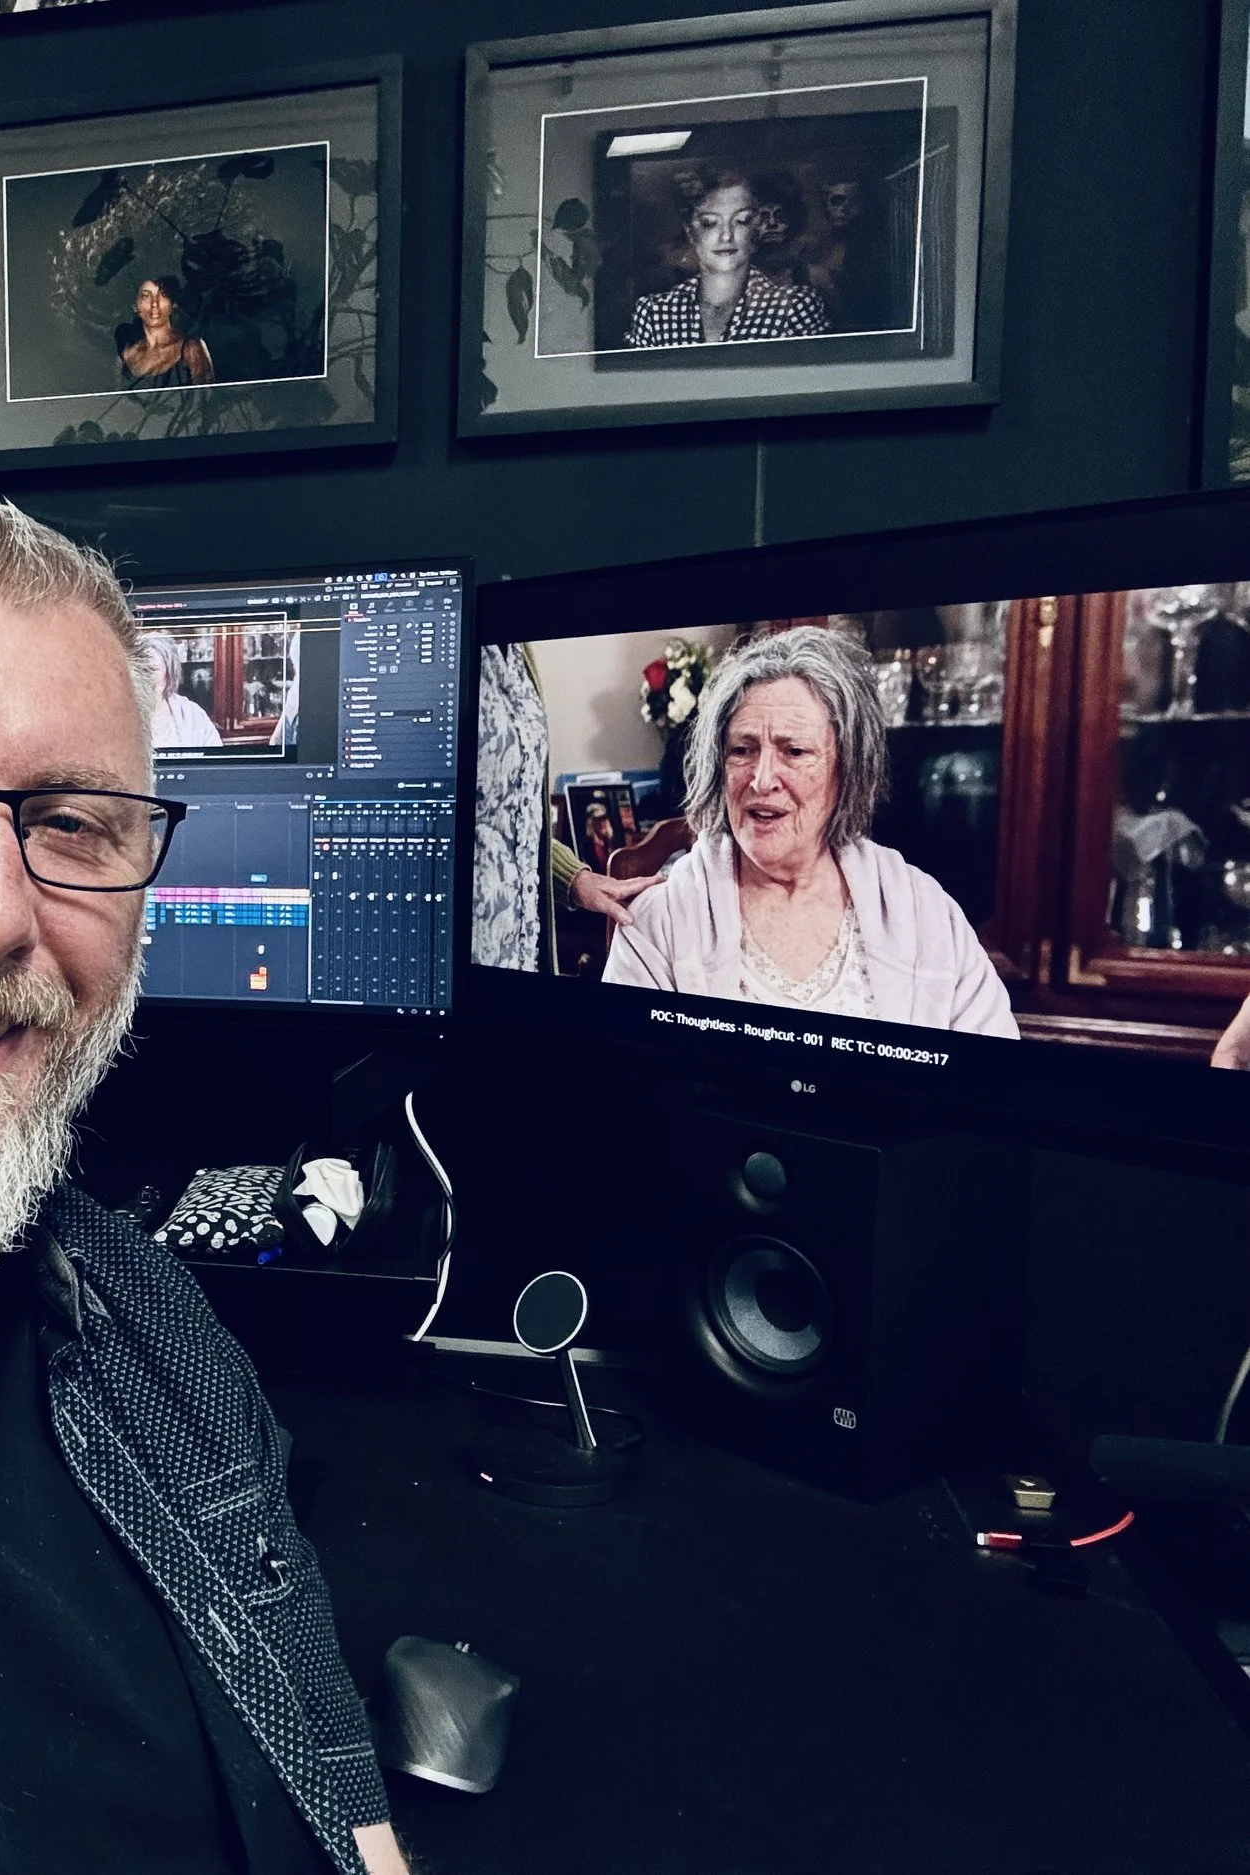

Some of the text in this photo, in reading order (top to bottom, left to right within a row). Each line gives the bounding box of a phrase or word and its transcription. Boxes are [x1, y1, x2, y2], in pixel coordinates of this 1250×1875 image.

[650, 1009, 675, 1023] POC:
[675, 1012, 736, 1032] Thoughtless
[744, 1023, 795, 1042] Roughcut
[803, 1032, 823, 1047] 001
[831, 1037, 855, 1052] REC
[856, 1040, 876, 1055] TC:
[877, 1044, 950, 1066] 00:00:29:17
[803, 1083, 816, 1094] LG
